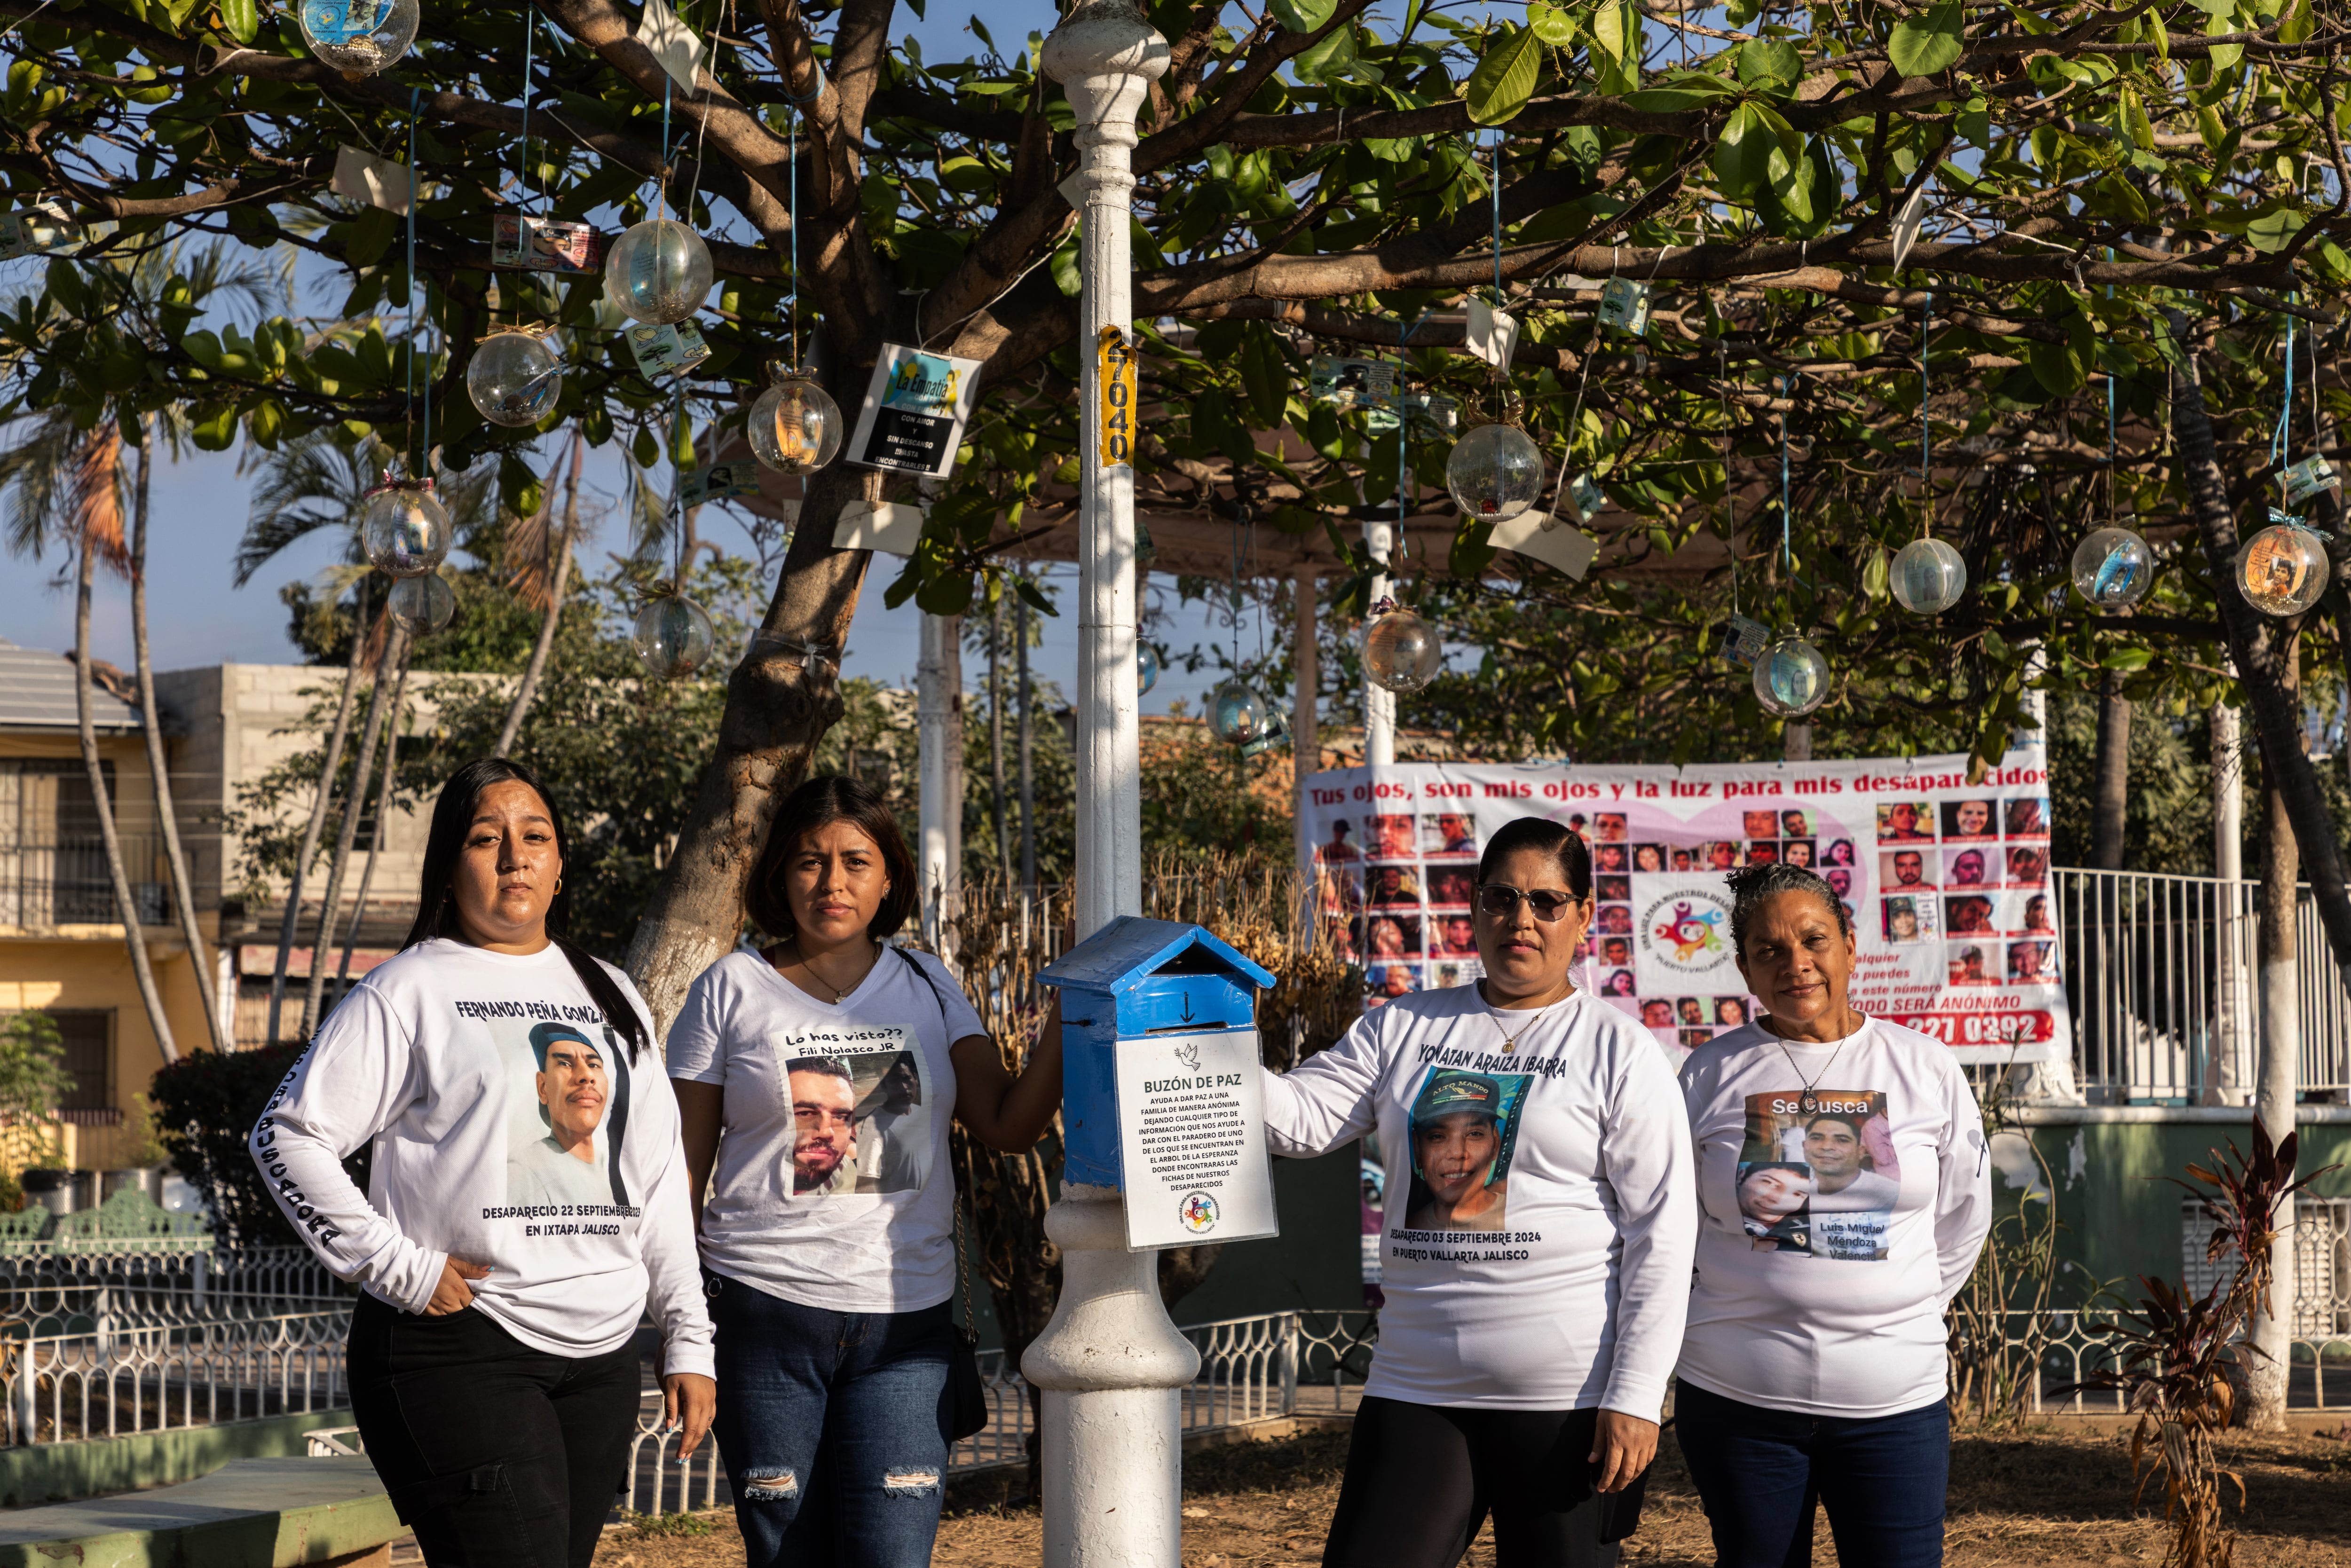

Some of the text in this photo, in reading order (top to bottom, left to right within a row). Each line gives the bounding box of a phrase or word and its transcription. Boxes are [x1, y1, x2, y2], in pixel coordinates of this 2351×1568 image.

[896, 370, 909, 391] La
[1108, 330, 1128, 460] 27040
[917, 406, 940, 415] FUERZ
[917, 418, 935, 426] AMOR
[887, 435, 933, 449] SIN DESCANSO
[875, 456, 925, 470] ENCONTRARLES
[1310, 767, 2047, 806] Tus ojos, son mis ojos y la luz para mis desaparcidos
[1863, 968, 1910, 982] puedes
[1862, 985, 1889, 996] este
[1894, 982, 1942, 995] número
[1853, 993, 2021, 1012] ODO SERÁ ANÓNIMO
[455, 1000, 604, 1024] FERNANDO PEÑA GONZ
[1964, 1014, 2037, 1043] 0392
[786, 1028, 903, 1046] Lo has visto??
[799, 1042, 895, 1057] Fili Nolasco JR
[1472, 1052, 1520, 1076] ARAIZA
[1522, 1056, 1567, 1079] IBARRA
[1144, 1074, 1241, 1093] BUZÓN DE PAZ
[1433, 1081, 1489, 1096] ALTO MANDO
[1772, 1099, 1868, 1114] Se usca
[1144, 1117, 1174, 1126] DEJANDO
[1176, 1113, 1212, 1122] CUALQUIER
[1139, 1126, 1185, 1135] INFORMACIÓN
[1182, 1132, 1216, 1141] PARADERO
[1190, 1141, 1233, 1150] ENCUENTRAN
[1202, 1150, 1238, 1158] ESPERANZA
[1177, 1161, 1224, 1171] ENCONTRARAS
[257, 1117, 342, 1249] BUSCADORA
[1171, 1181, 1223, 1191] DESAPARECIDOS
[482, 1205, 641, 1220] DESAPARECIO 22 SEPTIEMBRE 2023
[1205, 1192, 1220, 1220] DESAPARECIDOS
[526, 1223, 620, 1237] EN IXTAPA JALISCO
[1821, 1223, 1885, 1235] Luis Miguel
[1390, 1229, 1541, 1246] DESAPARECIO 03 SEPTIEMBRE 2024
[1827, 1236, 1877, 1247] Mendoza
[1393, 1247, 1529, 1264] EN PUERTO VALLARTA JALISCO
[1829, 1249, 1876, 1261] Valencia
